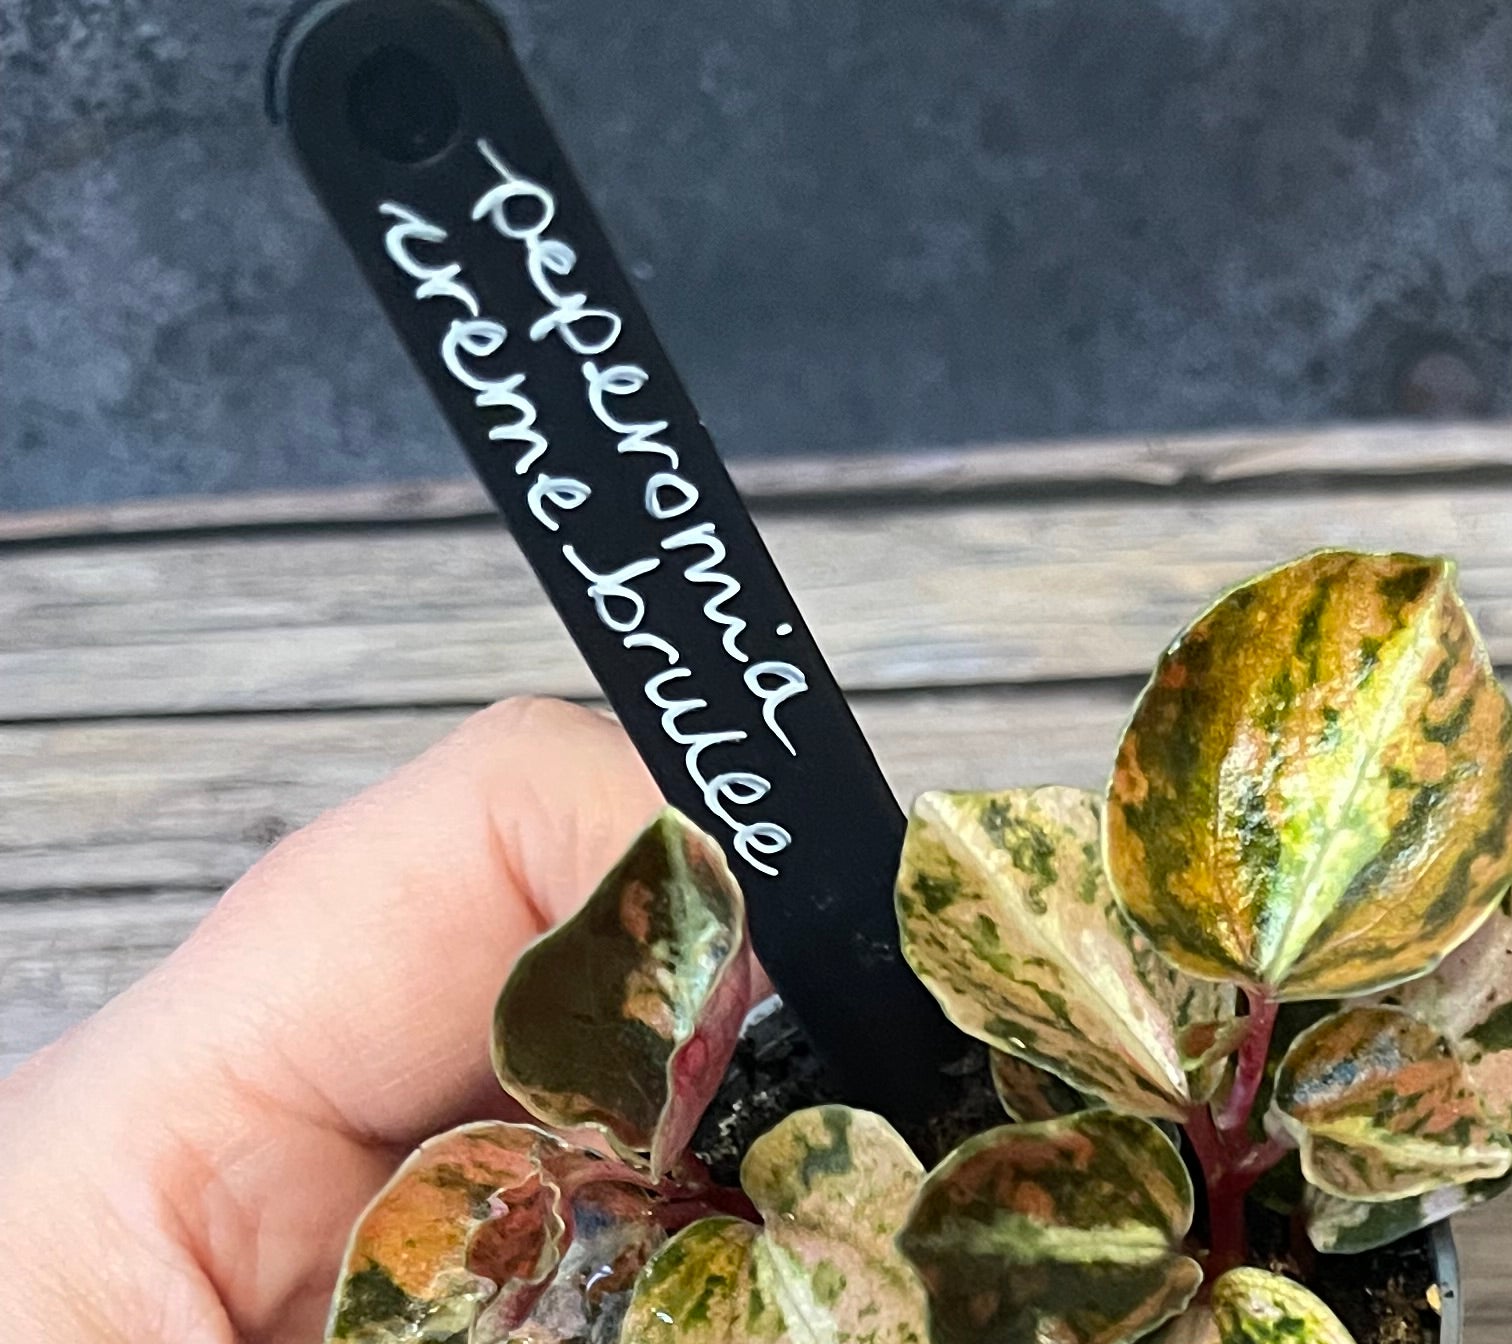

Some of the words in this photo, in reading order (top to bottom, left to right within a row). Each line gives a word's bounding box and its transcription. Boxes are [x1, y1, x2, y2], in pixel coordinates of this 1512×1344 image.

[379, 202, 593, 531] creme
[562, 544, 794, 877] brulee
[473, 138, 808, 757] peperomia
